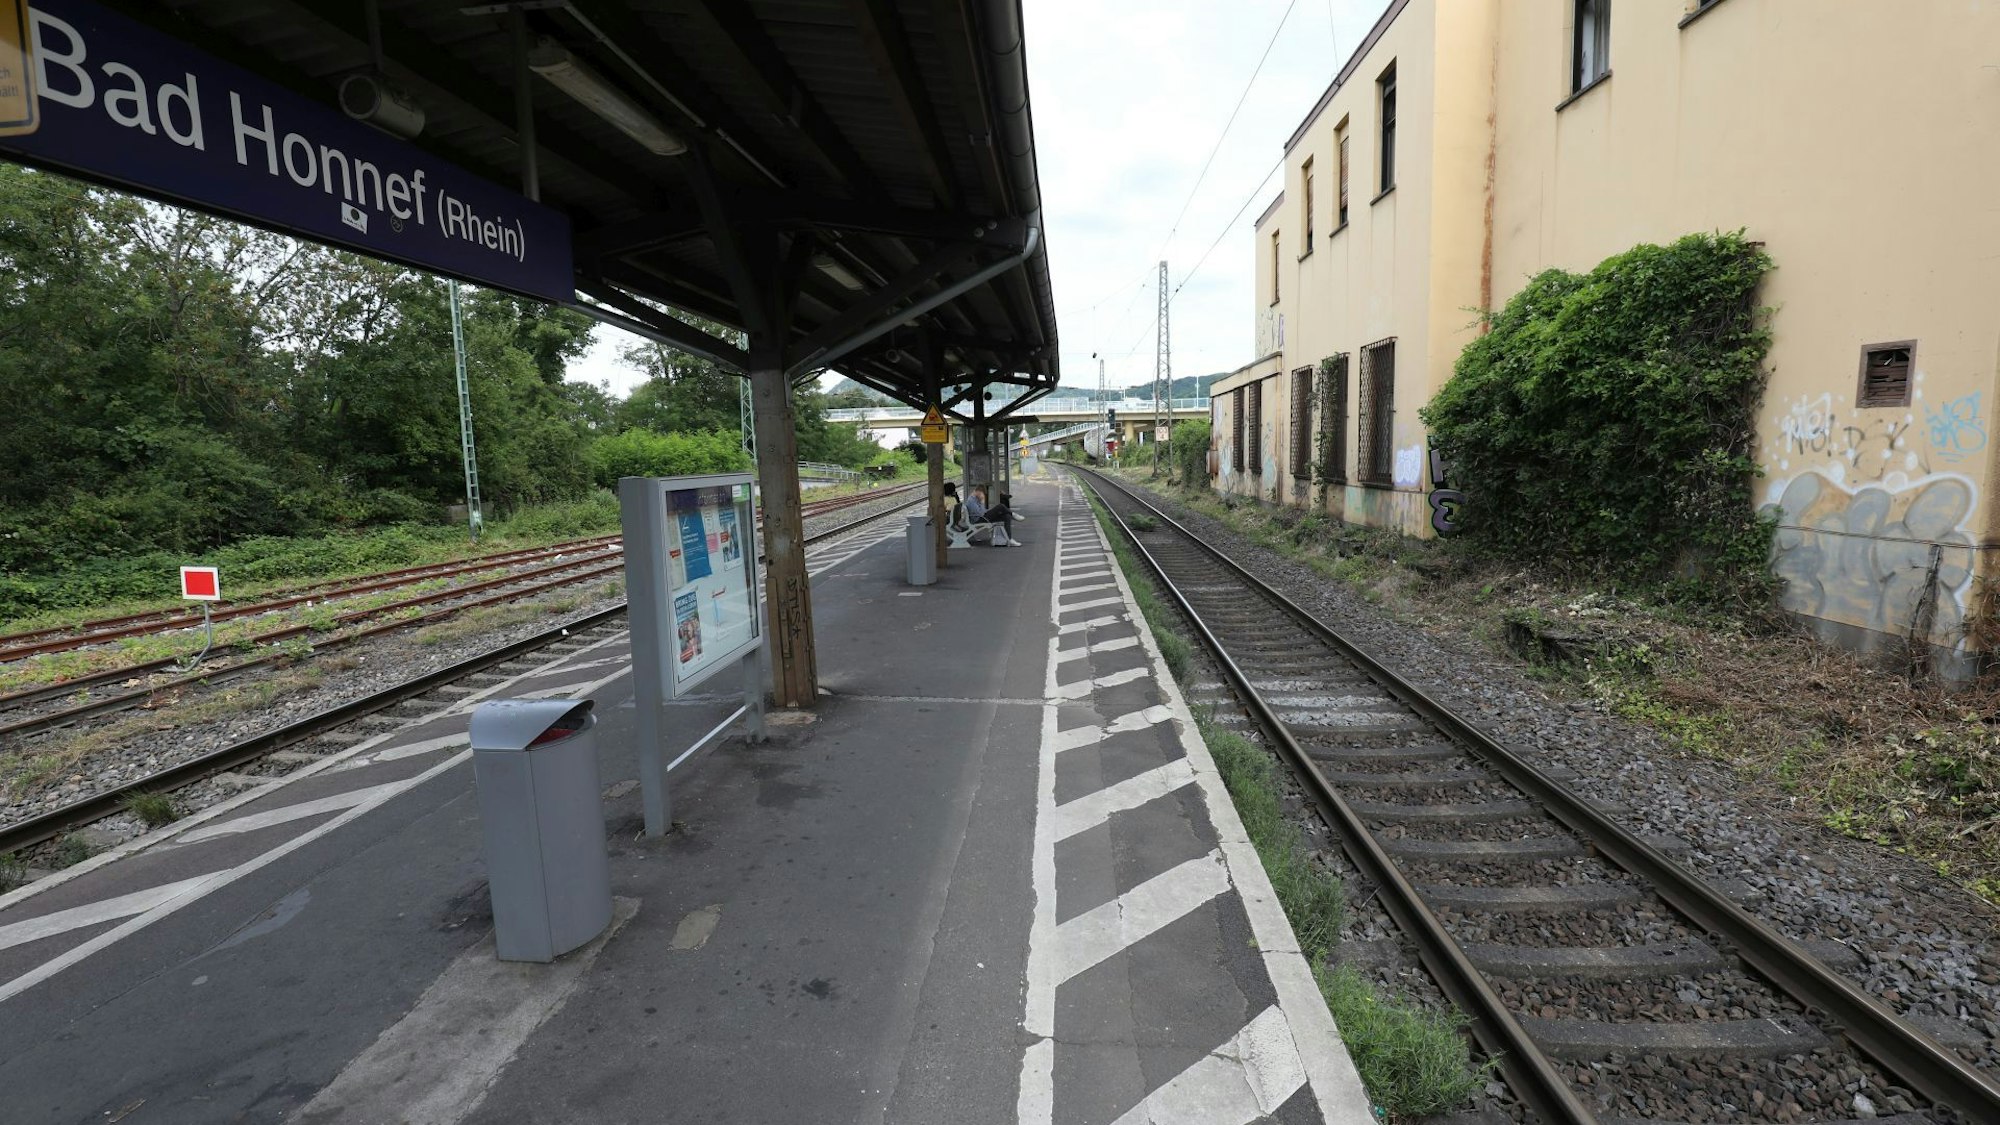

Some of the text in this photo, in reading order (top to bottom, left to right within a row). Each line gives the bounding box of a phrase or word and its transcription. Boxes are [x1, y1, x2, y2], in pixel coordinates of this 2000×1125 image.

[28, 6, 525, 263] Bad Honnef (Rhein)
